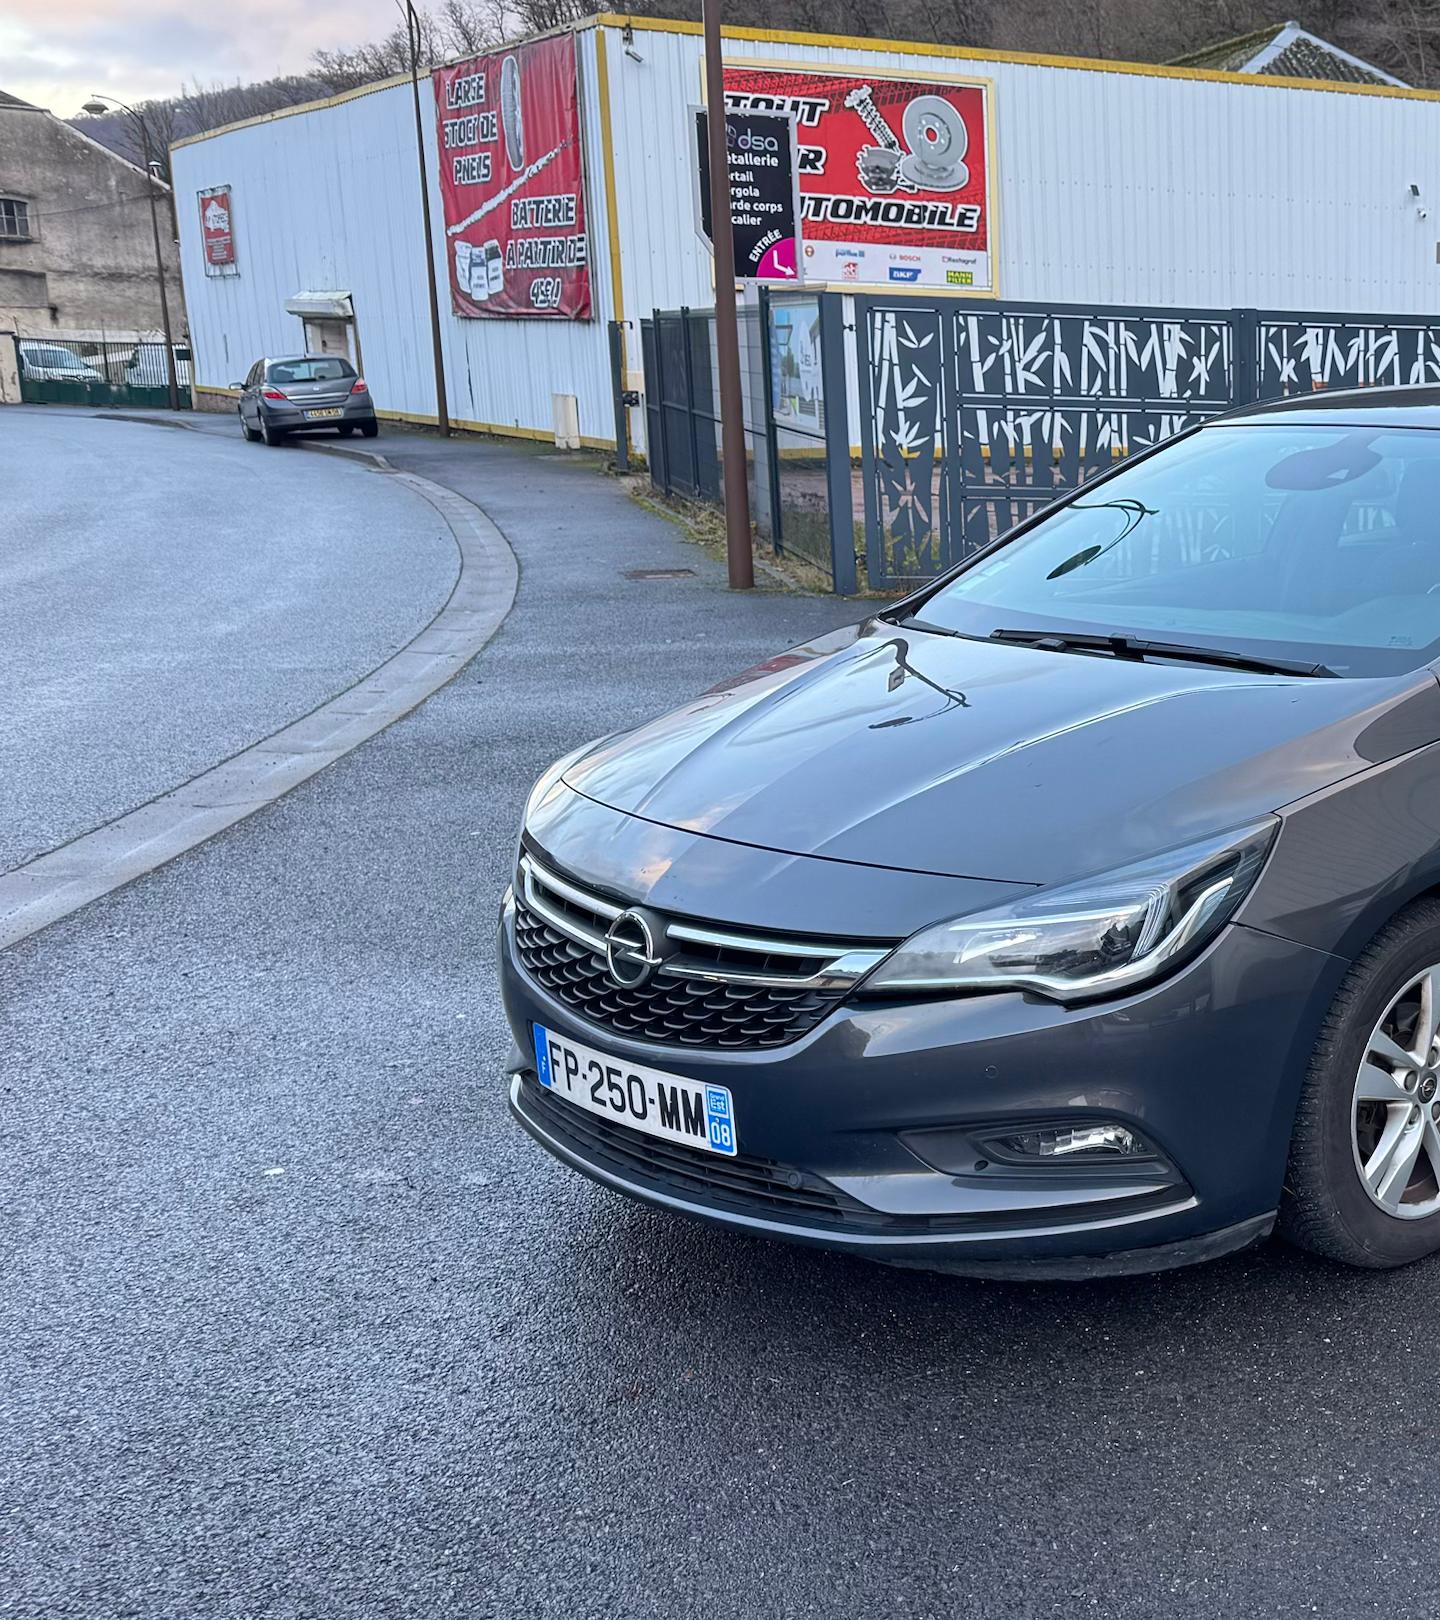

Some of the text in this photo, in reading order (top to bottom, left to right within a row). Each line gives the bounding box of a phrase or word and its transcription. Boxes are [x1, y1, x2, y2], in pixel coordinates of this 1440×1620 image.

[738, 128, 778, 151] dsa
[727, 152, 779, 167] étallerie
[730, 171, 754, 182] rtail
[730, 186, 760, 198] rgola
[731, 201, 783, 214] rde corps
[800, 192, 982, 233] TOMOBILE
[731, 214, 762, 225] calier
[749, 228, 783, 263] ENTRÉE
[548, 1039, 707, 1139] FP-250-MM
[711, 1121, 731, 1147] 08
